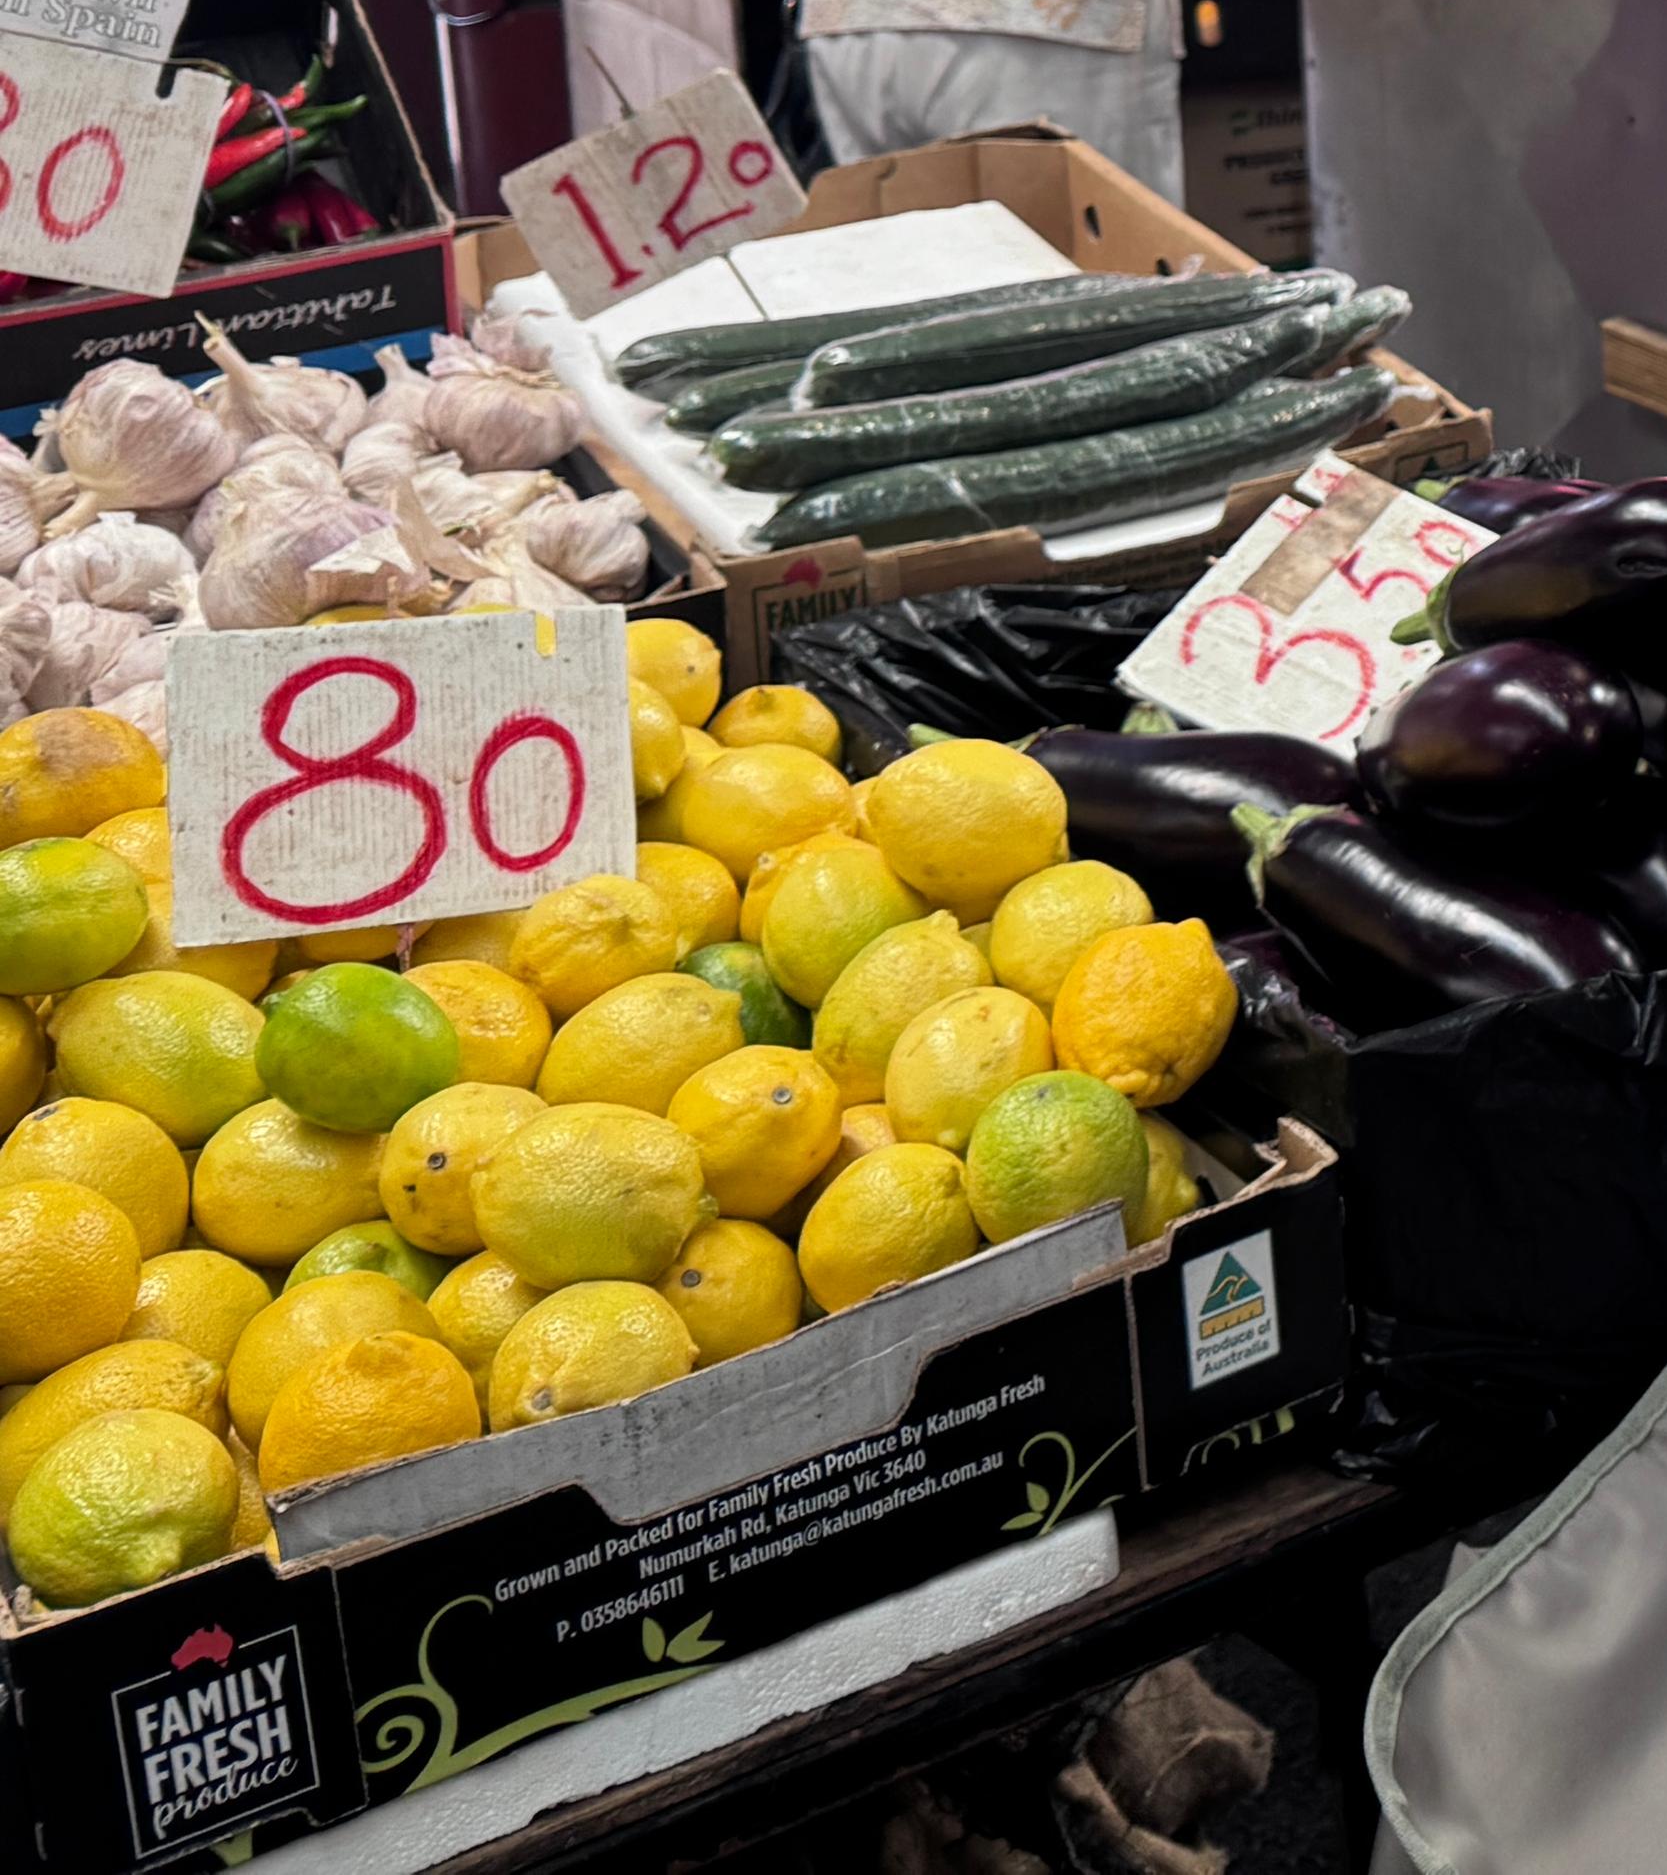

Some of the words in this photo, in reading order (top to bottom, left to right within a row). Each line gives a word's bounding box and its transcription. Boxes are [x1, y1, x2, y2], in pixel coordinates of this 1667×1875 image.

[72, 323, 198, 361] Limes
[219, 655, 586, 925] 80
[1196, 1327, 1255, 1362] Produce
[1258, 1318, 1271, 1336] of
[1202, 1339, 1270, 1377] Australia
[495, 1563, 561, 1602] Grown
[564, 1544, 602, 1577] and
[605, 1521, 674, 1561] Packed
[676, 1507, 705, 1536] for
[708, 1482, 770, 1523] Family
[773, 1462, 823, 1499] Fresh
[825, 1436, 898, 1477] Produce
[900, 1424, 923, 1450] By
[926, 1394, 998, 1437] Katunga
[1000, 1373, 1046, 1409] Fresh
[639, 1525, 738, 1579] Numurkah
[741, 1514, 772, 1541] Rd,
[775, 1481, 850, 1527] Katunga
[853, 1469, 880, 1496] Vic
[882, 1448, 927, 1485] 3640
[557, 1620, 578, 1643] P.
[580, 1573, 685, 1633] 0358646111
[708, 1558, 727, 1583] E.
[730, 1450, 1004, 1576] katunga@katungafresh.com.au
[135, 1653, 288, 1753] FAMILY
[143, 1704, 293, 1806] FRESH
[152, 1756, 299, 1841] produce
